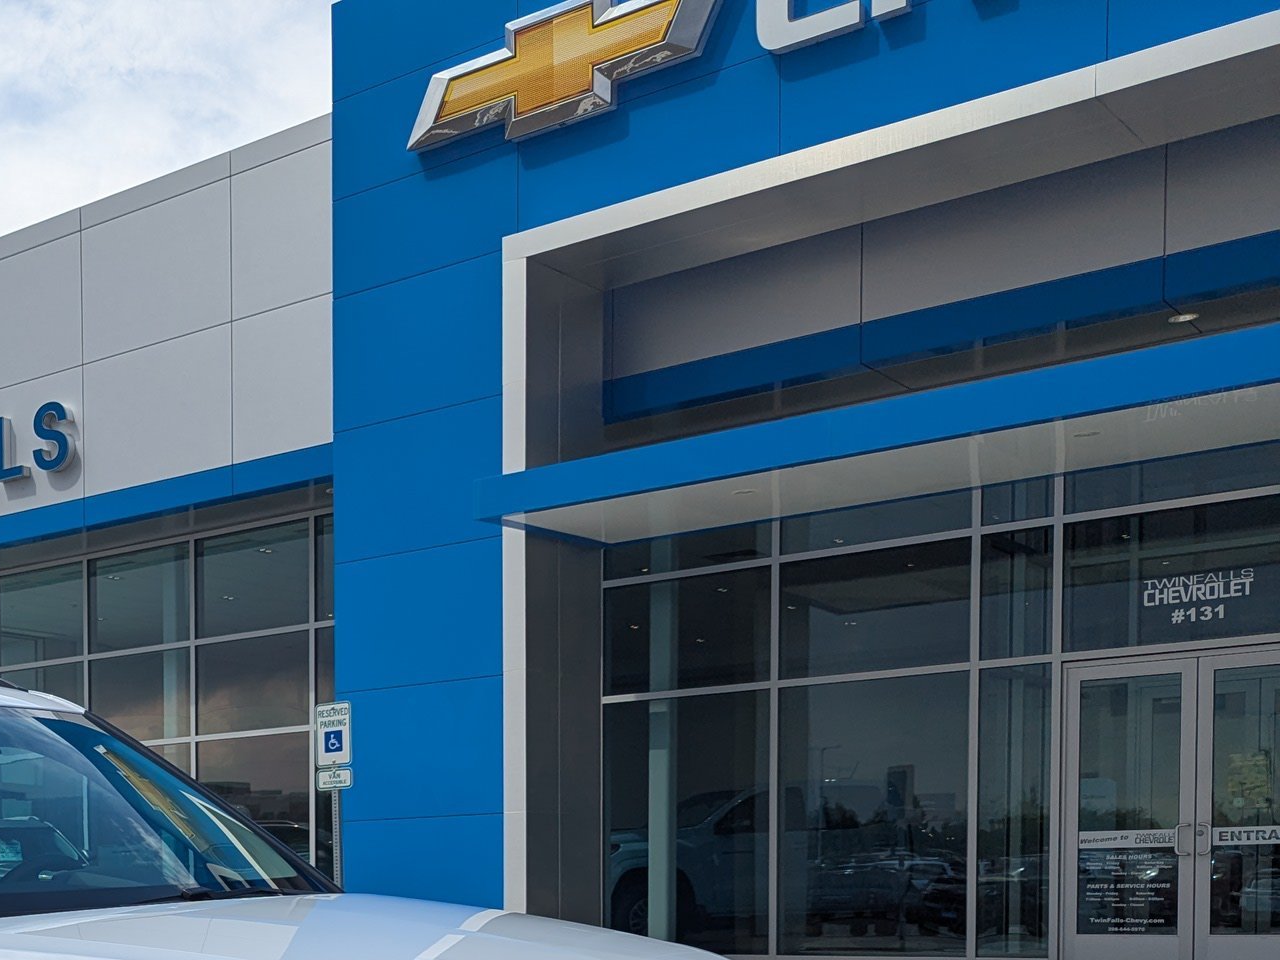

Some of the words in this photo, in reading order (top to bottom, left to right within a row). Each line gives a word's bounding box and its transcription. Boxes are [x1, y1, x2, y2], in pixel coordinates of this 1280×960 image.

[1143, 578, 1254, 606] CHEVROLET
[1171, 604, 1225, 624] #131
[318, 707, 348, 719] RESERVED
[320, 718, 347, 729] PARKING
[1080, 836, 1118, 844] Welcome
[1134, 836, 1175, 844] CHEVROLE
[1219, 829, 1280, 841] ENTRA
